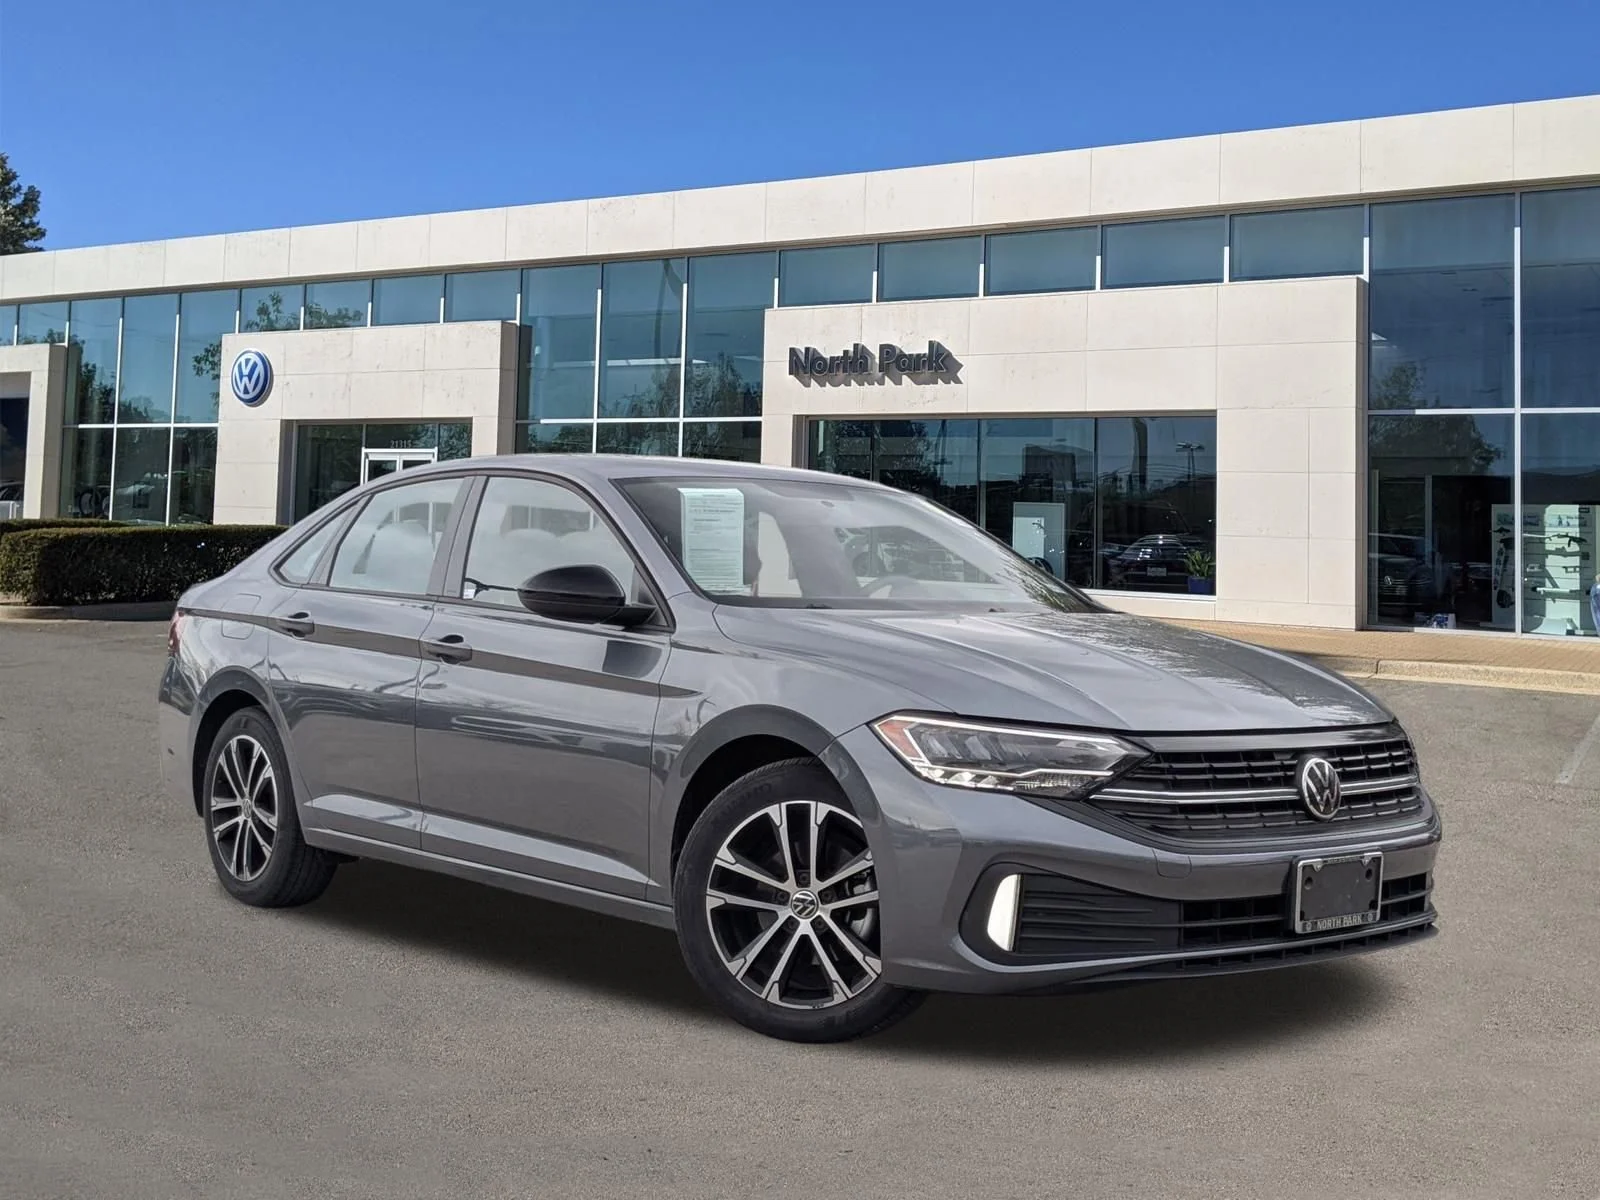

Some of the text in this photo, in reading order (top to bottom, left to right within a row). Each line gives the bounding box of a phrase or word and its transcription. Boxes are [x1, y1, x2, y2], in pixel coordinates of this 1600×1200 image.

[232, 351, 267, 402] VW
[788, 339, 949, 376] North Park
[1302, 758, 1341, 817] VW
[1316, 914, 1362, 930] NORTH PARK
